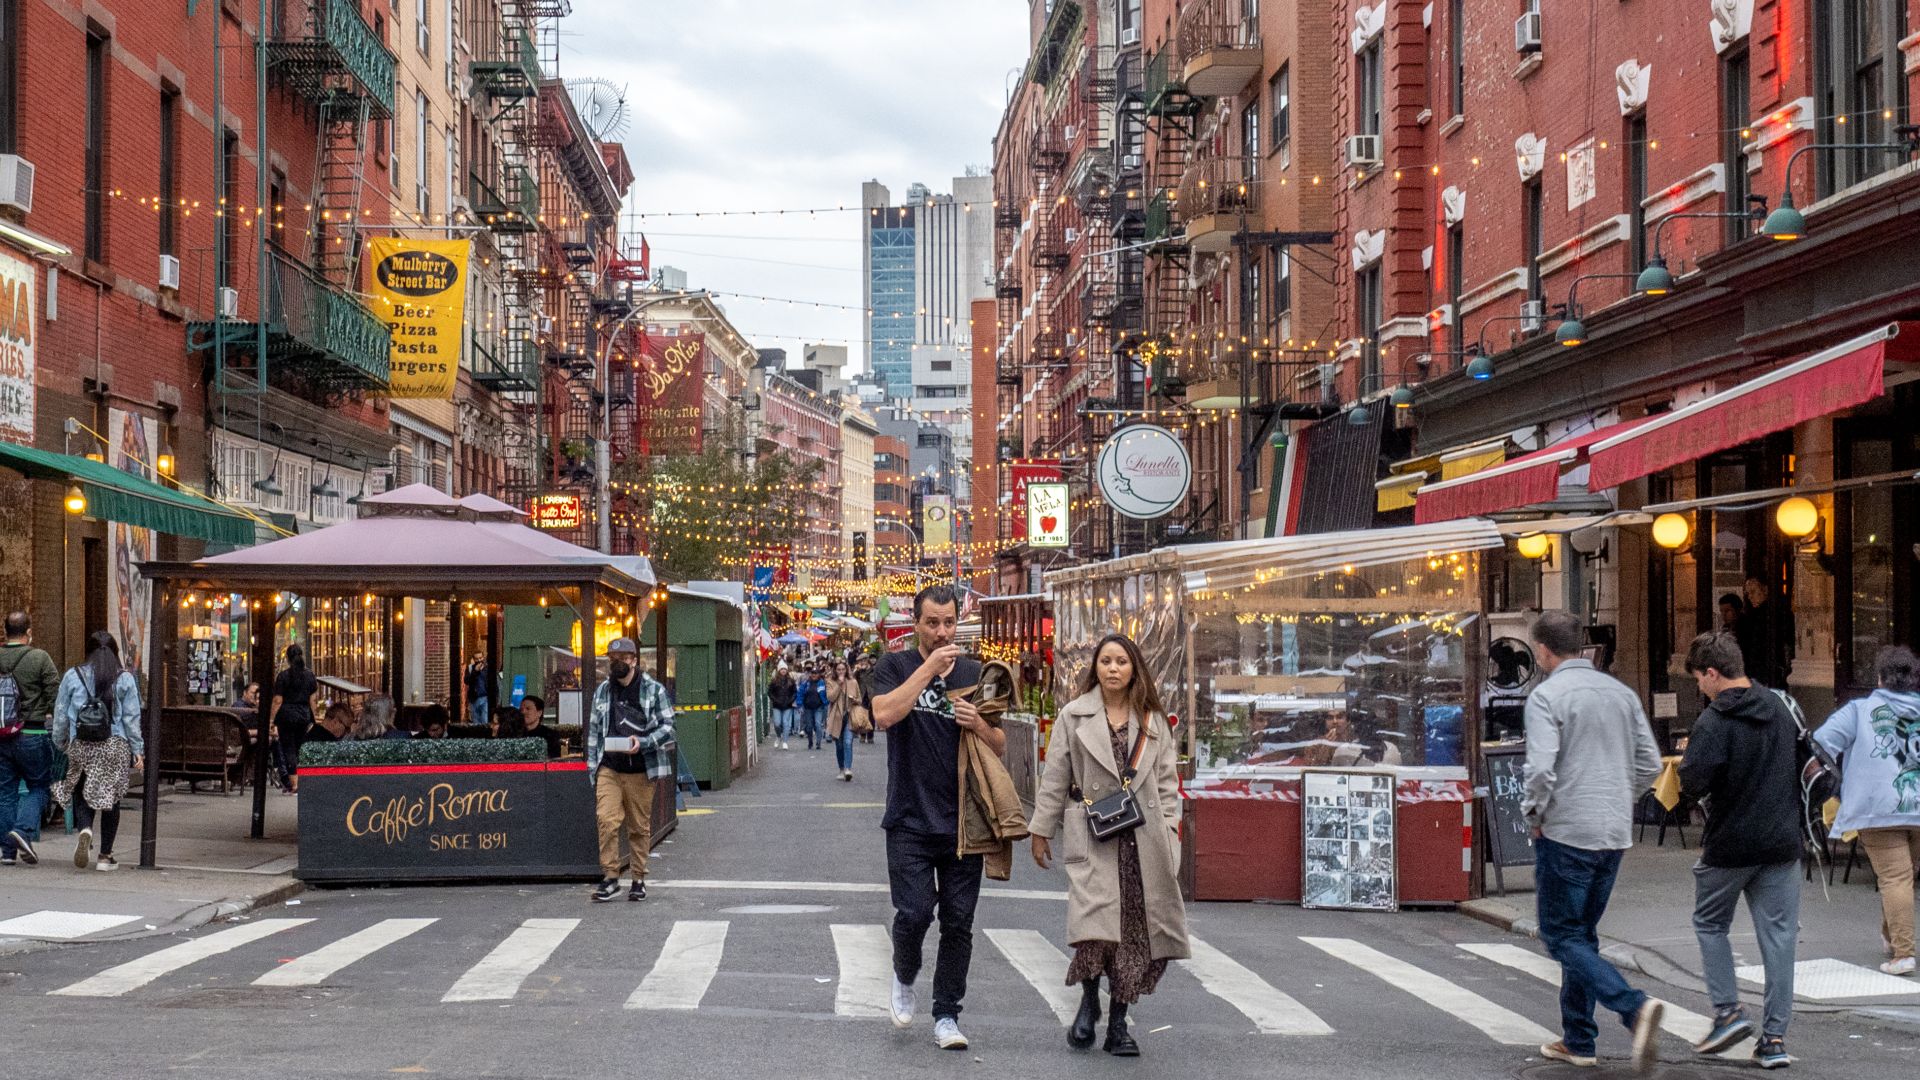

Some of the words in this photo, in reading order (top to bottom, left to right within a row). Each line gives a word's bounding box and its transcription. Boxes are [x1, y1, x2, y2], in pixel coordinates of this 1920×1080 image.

[392, 256, 447, 275] Mulberry
[387, 273, 422, 288] Street
[425, 274, 447, 289] Bar
[393, 304, 435, 318] Beer
[389, 322, 438, 336] Pizza
[390, 341, 439, 354] Pasta
[390, 361, 447, 376] urgers
[1122, 453, 1180, 472] Lunella
[1033, 489, 1051, 503] LA
[1035, 498, 1061, 513] MELA
[346, 795, 426, 845] Caffè
[428, 783, 513, 826] Roma
[429, 834, 472, 851] SINCE
[478, 832, 507, 849] 1891
